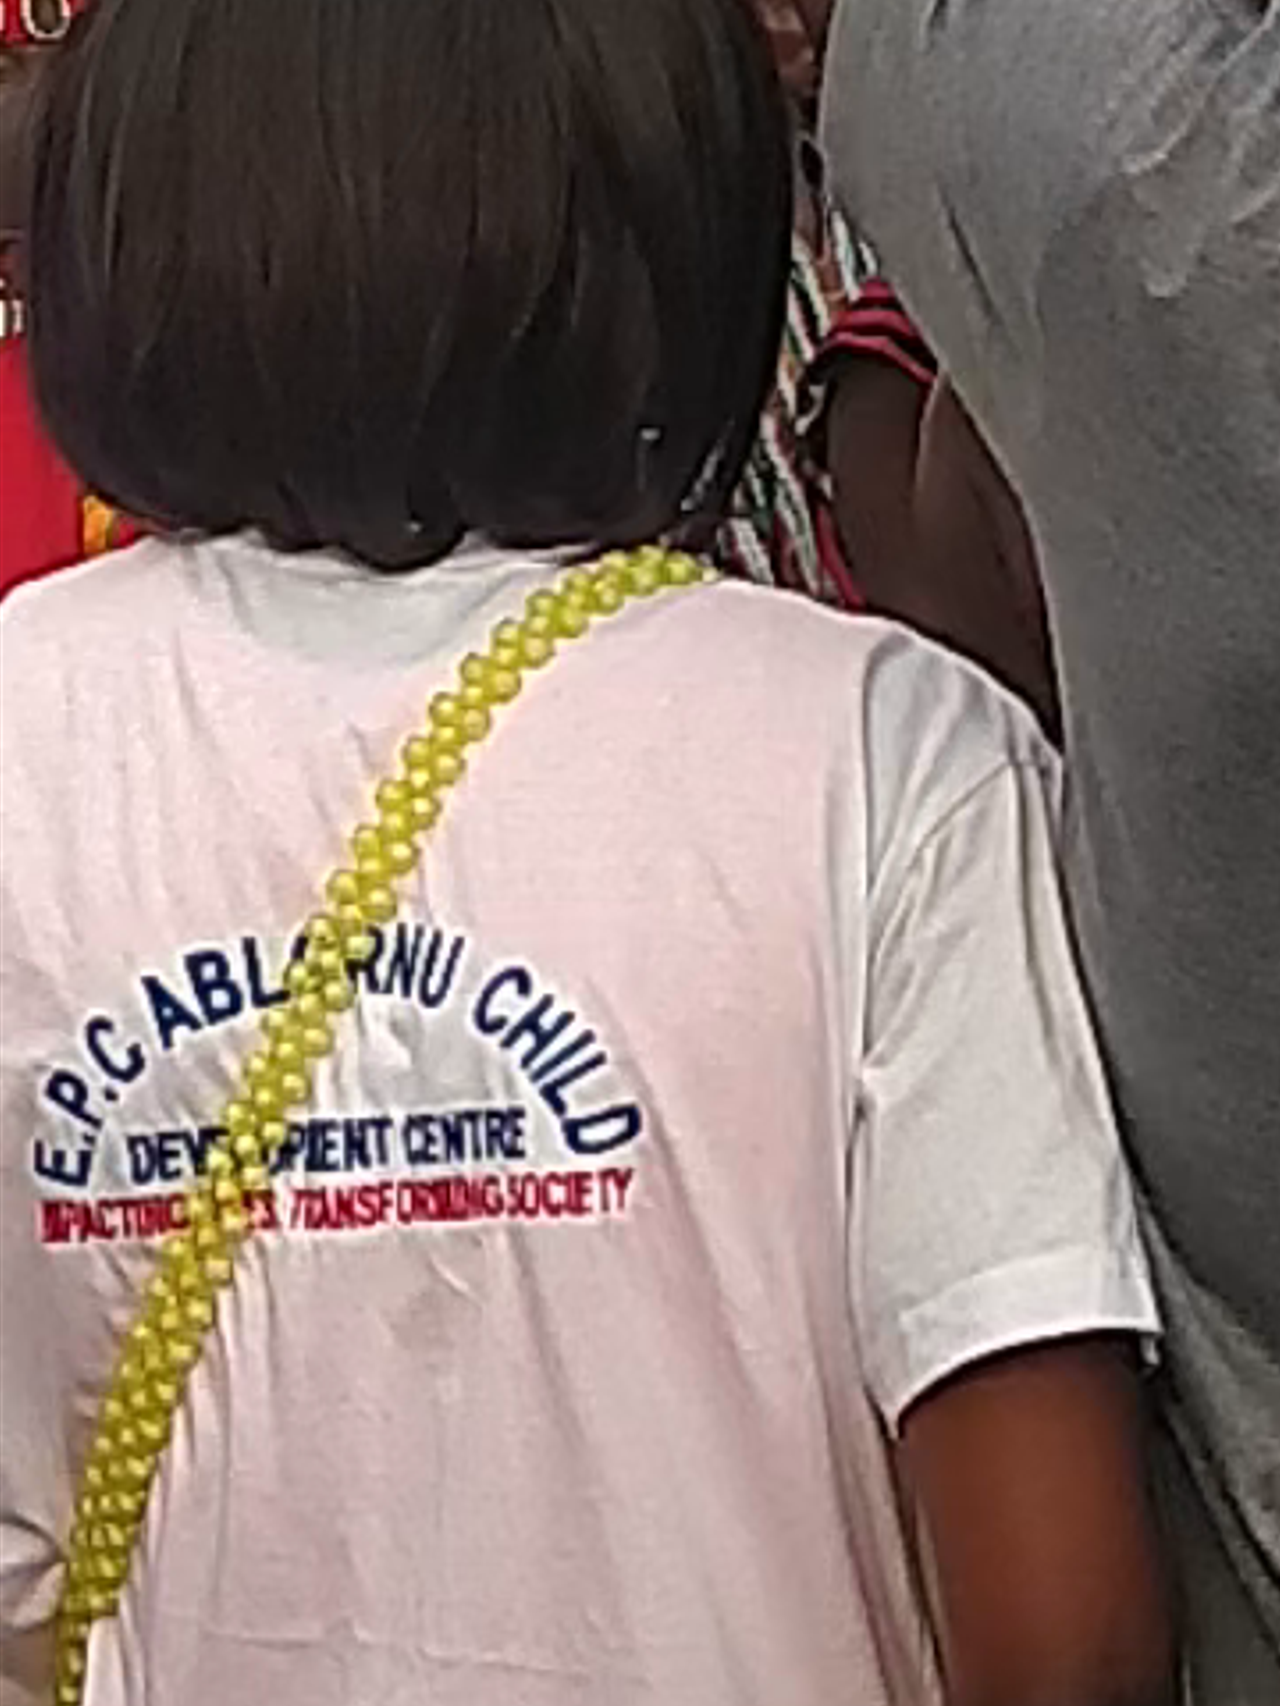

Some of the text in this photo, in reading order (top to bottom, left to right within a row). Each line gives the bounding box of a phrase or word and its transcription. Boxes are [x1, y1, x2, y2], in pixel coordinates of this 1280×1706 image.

[141, 921, 465, 1050] ABLRNU
[473, 967, 642, 1155] CHILD
[402, 1107, 526, 1165] CENTRE
[505, 1168, 633, 1219] SOCIETY
